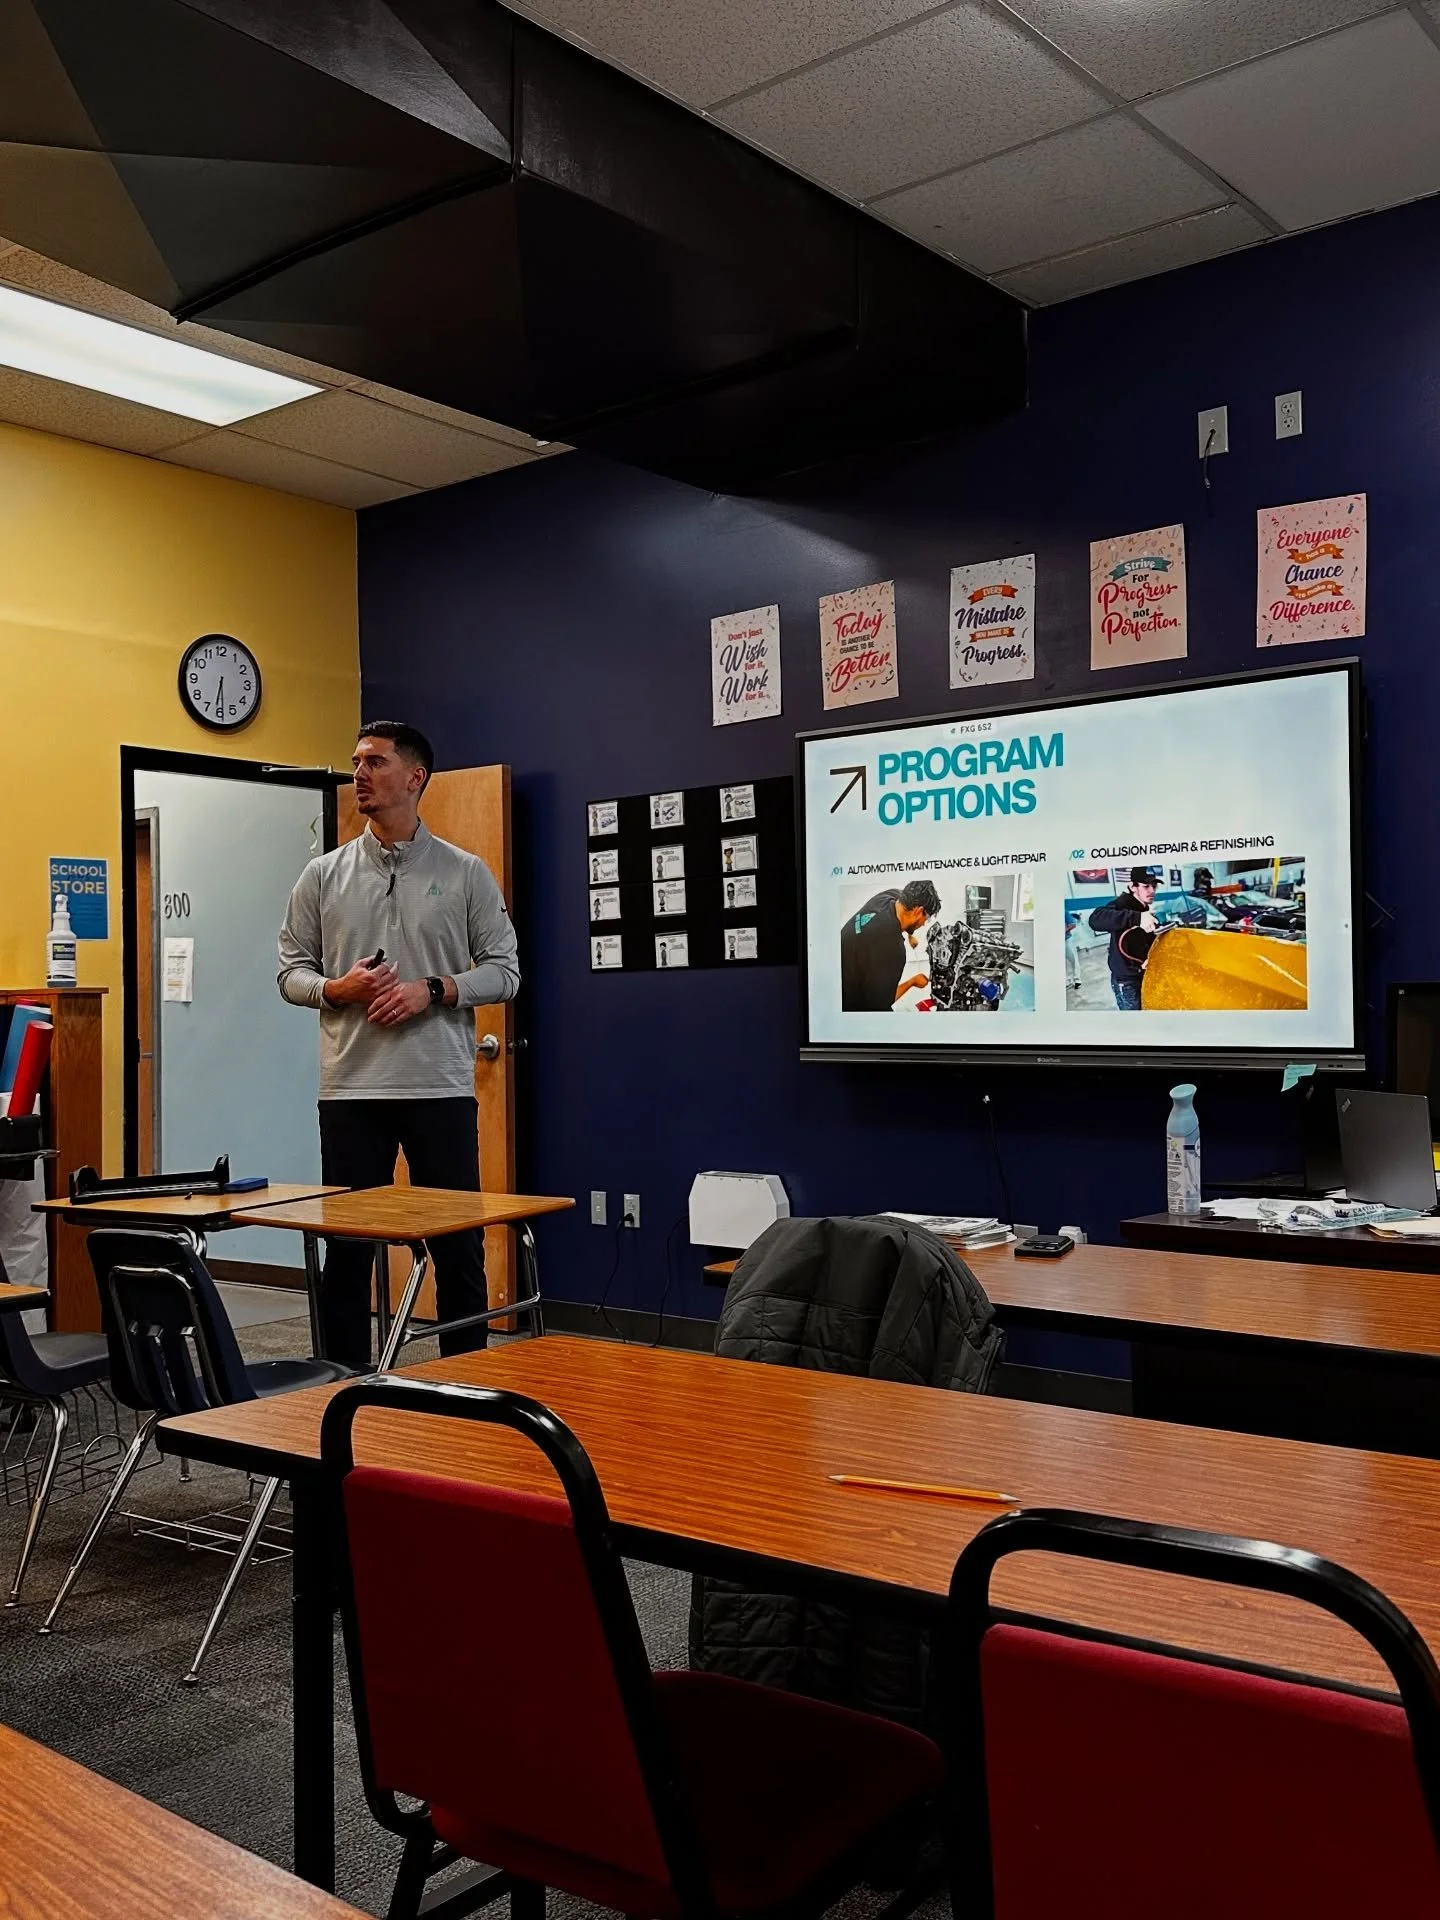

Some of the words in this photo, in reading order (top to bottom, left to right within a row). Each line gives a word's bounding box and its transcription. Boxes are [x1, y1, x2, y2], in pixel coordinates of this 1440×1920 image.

[1277, 527, 1352, 549] Everyone
[1124, 558, 1155, 572] Strive
[1132, 574, 1149, 583] For
[1285, 564, 1344, 584] Chance
[982, 587, 1002, 596] EVERY
[1098, 582, 1178, 614] Progress
[954, 605, 1026, 629] Mistake
[1132, 608, 1149, 618] not
[1270, 599, 1355, 623] Difference.
[832, 611, 887, 642] Today
[1101, 612, 1181, 644] Perfection.
[728, 631, 746, 641] Don't
[748, 628, 762, 639] just
[848, 634, 870, 644] ANOTHER
[204, 648, 212, 659] 11
[216, 646, 227, 656] 12
[840, 645, 859, 654] CHANCE
[962, 644, 1026, 665] Progress.
[233, 653, 237, 663] 1
[720, 639, 768, 674] Wish
[194, 658, 206, 669] 10
[744, 662, 756, 670] for
[240, 664, 247, 676] 2
[830, 650, 890, 693] Better
[190, 673, 198, 684] 9
[244, 680, 251, 691] 3
[720, 669, 768, 705] Work
[193, 690, 201, 700] 8
[239, 696, 246, 705] 4
[745, 692, 756, 700] for
[204, 702, 211, 712] 7
[216, 708, 224, 718] 6
[228, 705, 237, 715] 5
[960, 724, 975, 734] FXG
[878, 732, 1064, 786] PROGRAM
[878, 778, 1036, 826] OPTIONS
[1091, 845, 1147, 858] COLLISION
[1150, 842, 1189, 854] REPAIR
[1190, 841, 1198, 852] &
[1200, 836, 1274, 851] REFINISHING
[848, 862, 904, 875] AUTOMOTIVE
[906, 858, 972, 871] MAINTENANCE
[974, 857, 980, 866] &
[982, 855, 1010, 866] LIGHT
[1011, 853, 1046, 864] REPAIR
[52, 864, 107, 877] SCHOOL
[52, 880, 105, 894] STORE
[164, 892, 190, 919] 800
